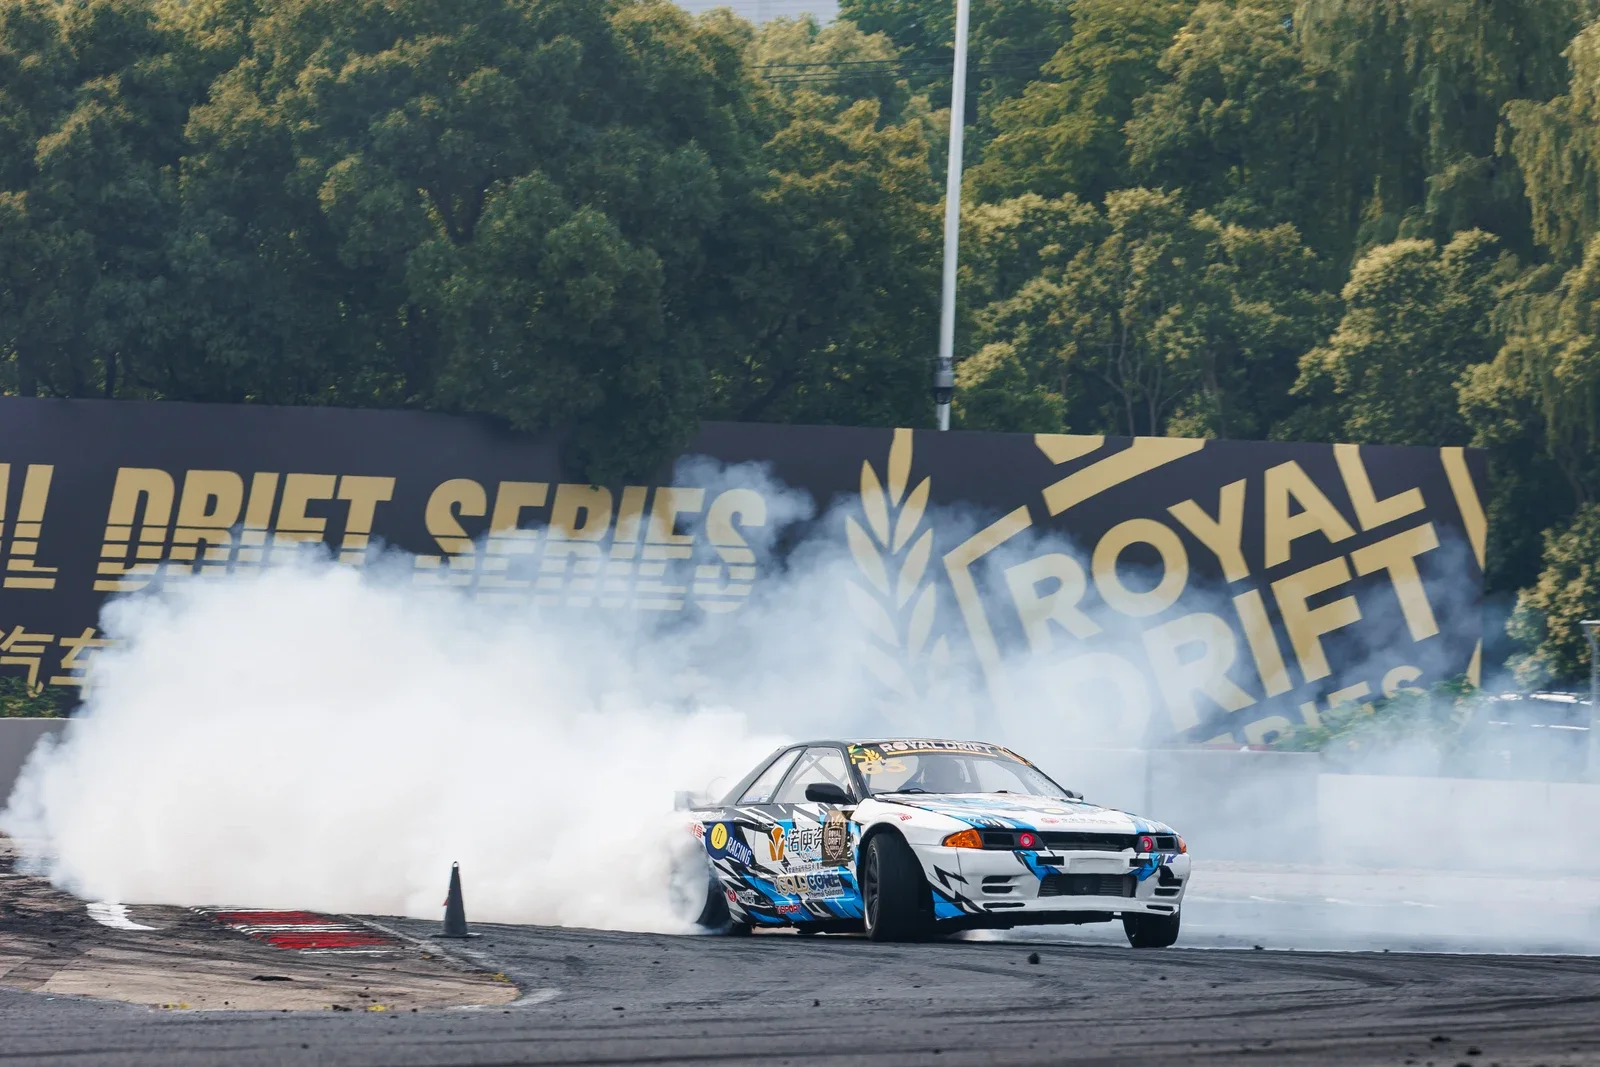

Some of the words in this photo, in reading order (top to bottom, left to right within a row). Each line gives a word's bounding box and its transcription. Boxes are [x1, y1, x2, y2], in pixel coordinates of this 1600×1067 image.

[0, 464, 58, 590] L
[93, 466, 396, 592] DRIFT
[412, 478, 769, 613] SERIES
[1004, 443, 1426, 656] ROYAL
[1015, 522, 1441, 746] DRIFT
[879, 740, 944, 753] ROYAL
[943, 741, 993, 754] DRIFT
[726, 836, 752, 866] RACING
[828, 837, 841, 846] DRIFT
